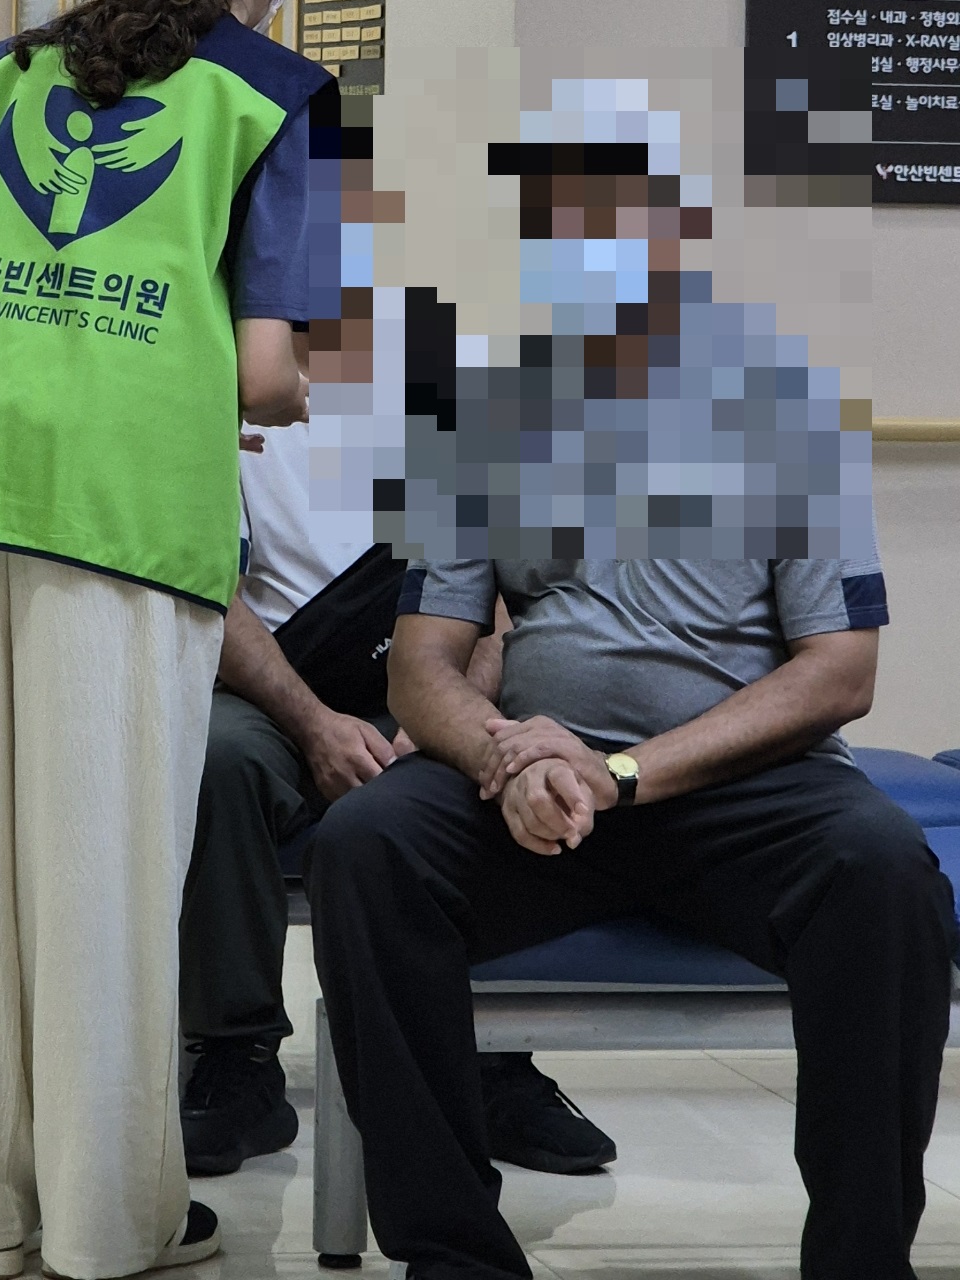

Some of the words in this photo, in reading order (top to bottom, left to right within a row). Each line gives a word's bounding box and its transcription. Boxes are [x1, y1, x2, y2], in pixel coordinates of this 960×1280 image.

[827, 9, 868, 26] 접수실
[880, 11, 908, 25] 내과
[786, 31, 798, 48] 1
[827, 32, 894, 48] 임상병리과
[905, 33, 960, 51] X-RAY실
[905, 56, 960, 73] 행정사무
[905, 94, 960, 111] 놀이치료
[94, 315, 159, 345] CLINIC
